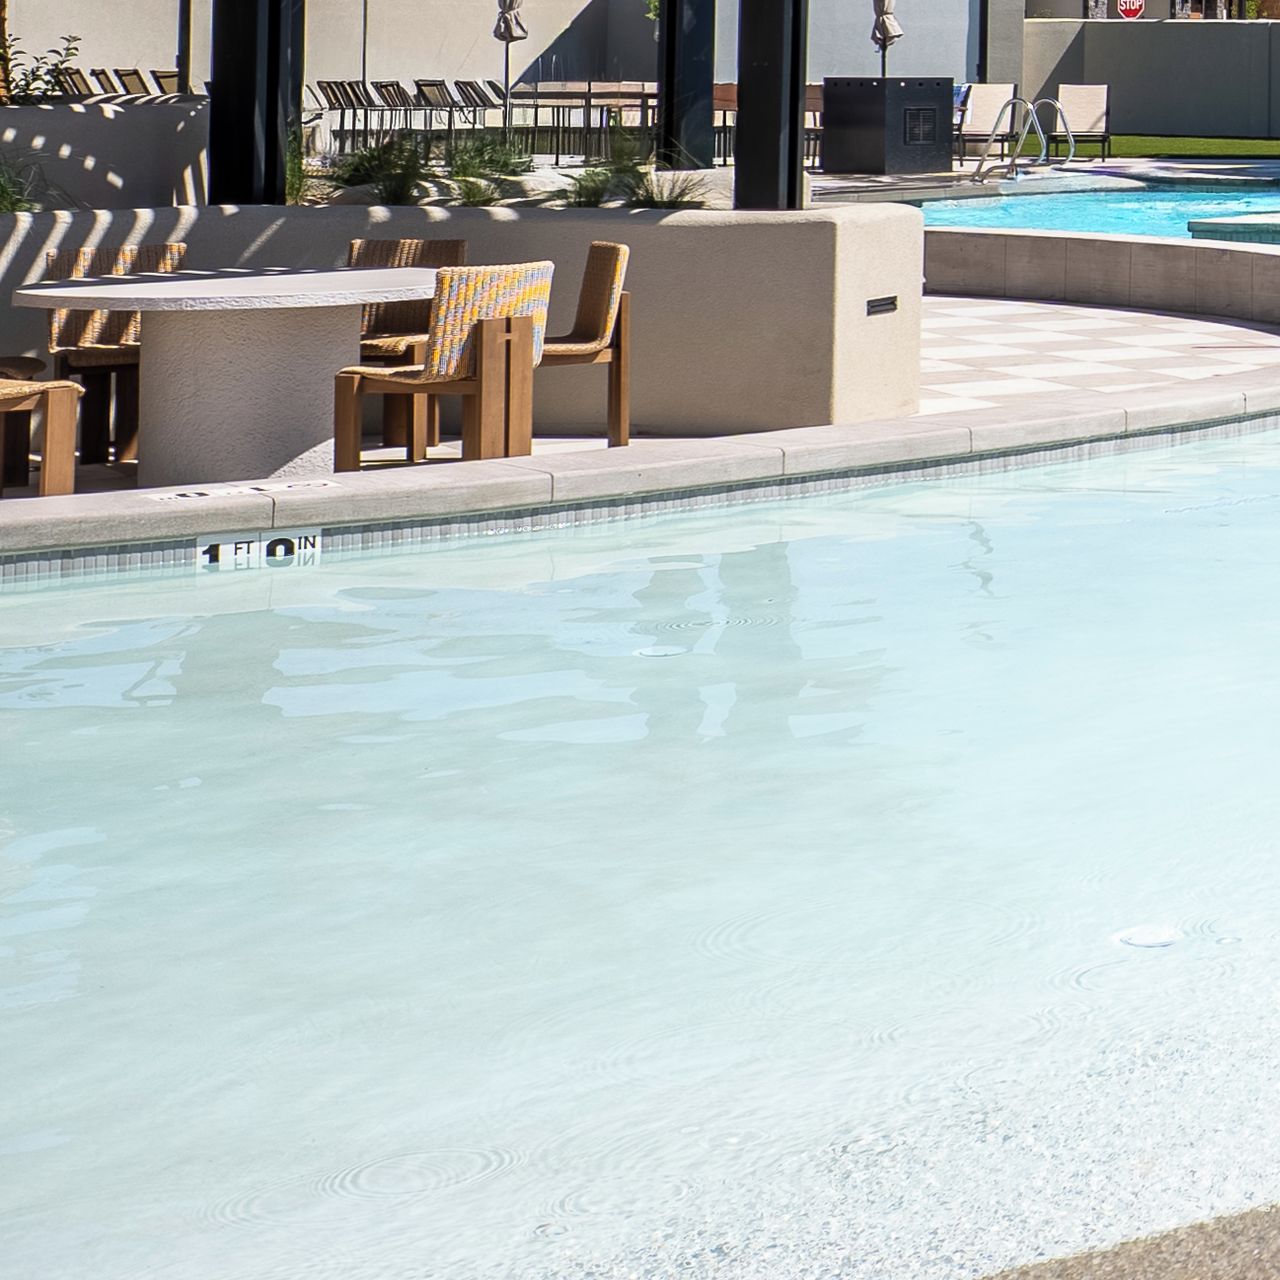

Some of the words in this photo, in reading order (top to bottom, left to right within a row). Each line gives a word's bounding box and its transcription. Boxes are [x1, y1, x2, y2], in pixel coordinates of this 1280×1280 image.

[202, 543, 219, 565] 1
[234, 540, 254, 556] FT
[266, 537, 294, 567] 0
[298, 535, 316, 550] IN
